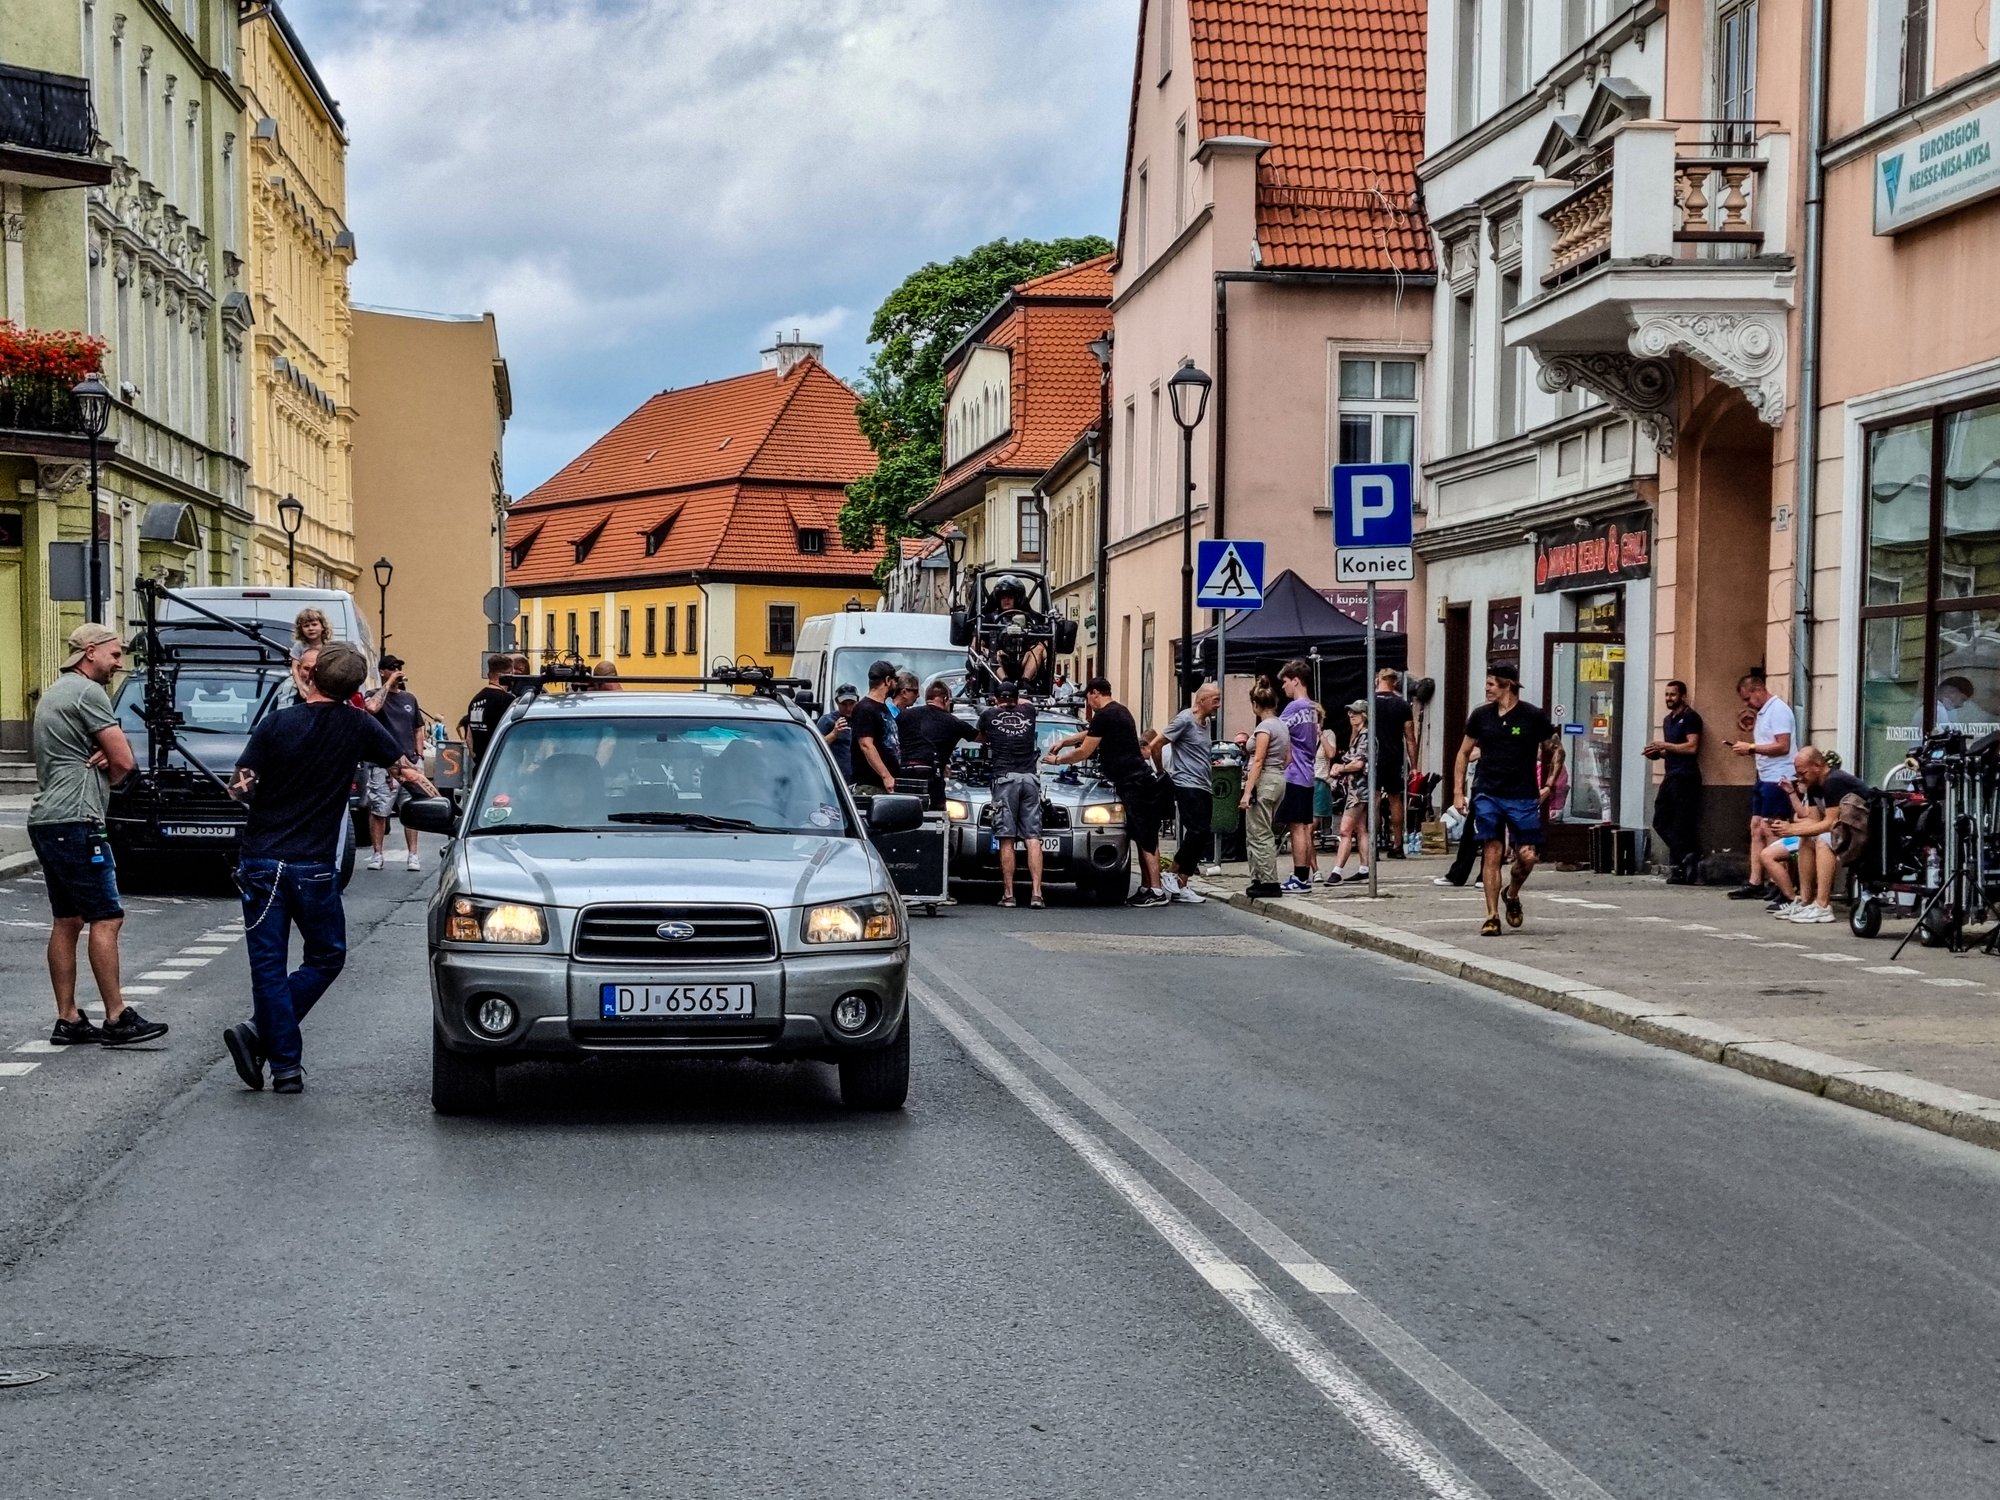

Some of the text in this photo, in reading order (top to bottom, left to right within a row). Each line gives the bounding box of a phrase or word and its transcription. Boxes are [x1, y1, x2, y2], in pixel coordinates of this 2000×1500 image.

[1920, 118, 1981, 163] EUROREGION
[1909, 142, 1991, 193] NEISSE-NISA-NYSA
[1350, 474, 1394, 537] P
[1578, 537, 1606, 574] KEBAB
[1607, 524, 1619, 574] &
[1621, 530, 1648, 567] GRILL
[1343, 555, 1407, 573] Koniec
[1072, 608, 1079, 617] 53
[1337, 594, 1369, 606] kupisz
[605, 1004, 615, 1012] PL
[619, 987, 744, 1012] DJ 6565J
